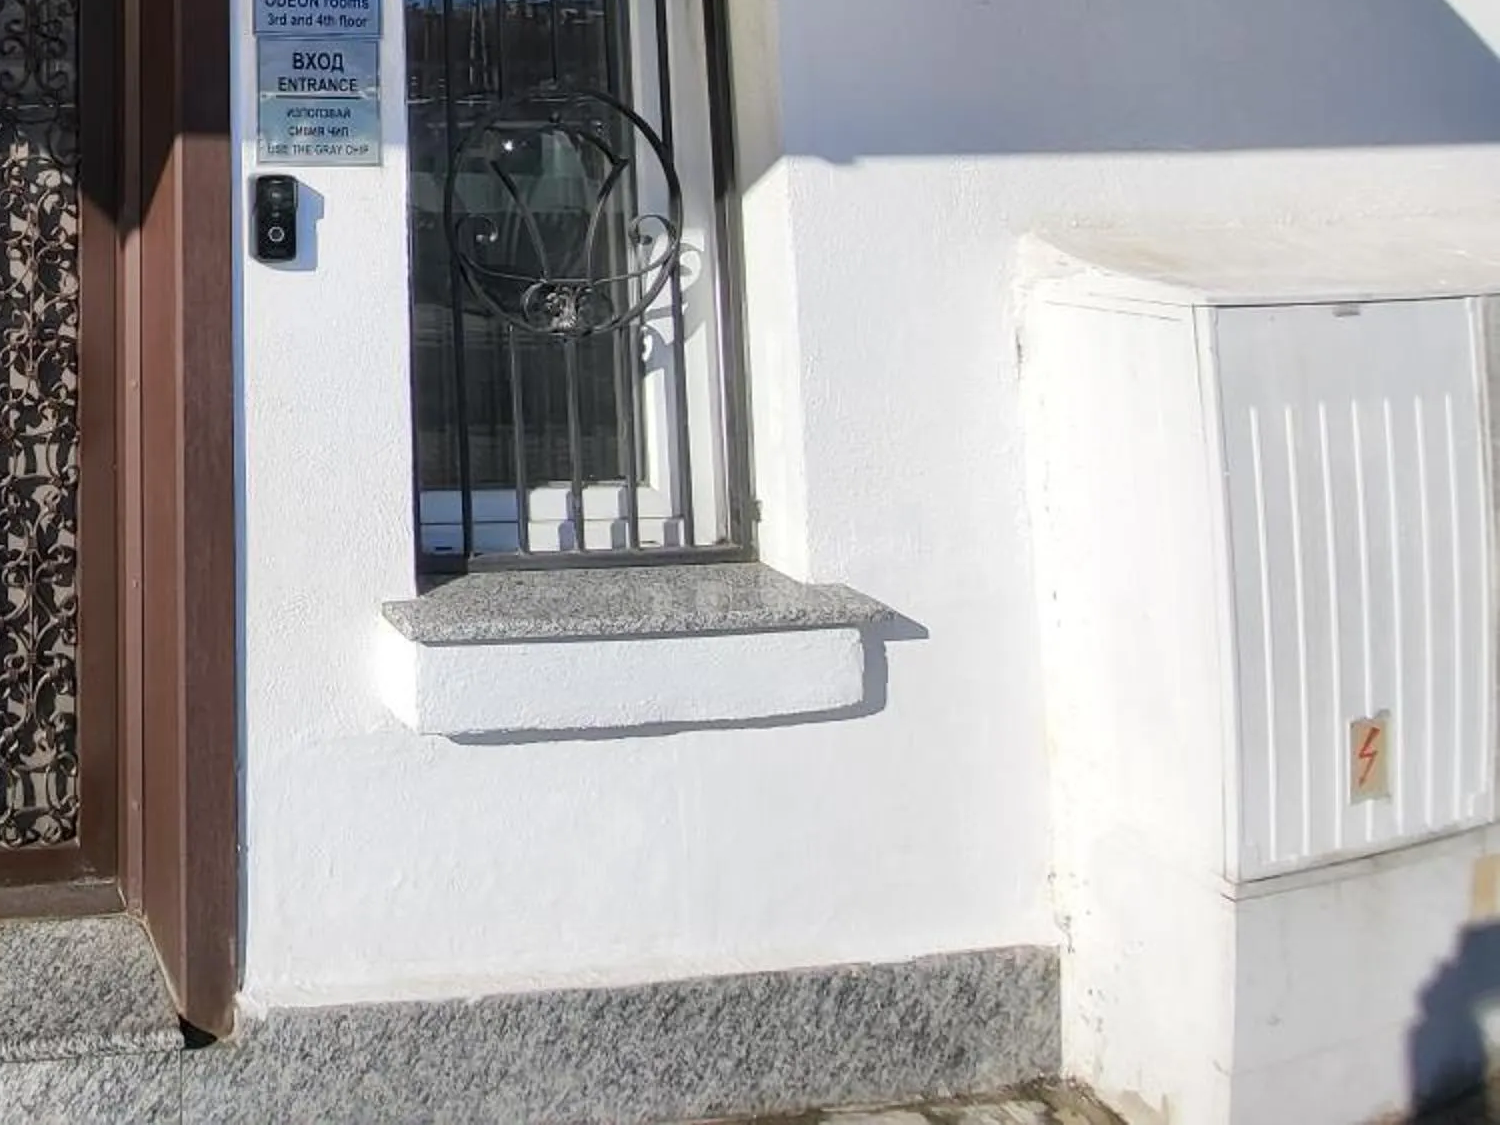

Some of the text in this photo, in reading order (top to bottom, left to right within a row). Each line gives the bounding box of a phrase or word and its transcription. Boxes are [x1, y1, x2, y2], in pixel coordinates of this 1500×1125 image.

[267, 13, 367, 28] 3rd and 4th floor
[292, 52, 344, 73] ВХОД
[277, 76, 358, 92] ENTRANCE
[328, 126, 349, 137] ЧИП
[293, 143, 310, 155] THE
